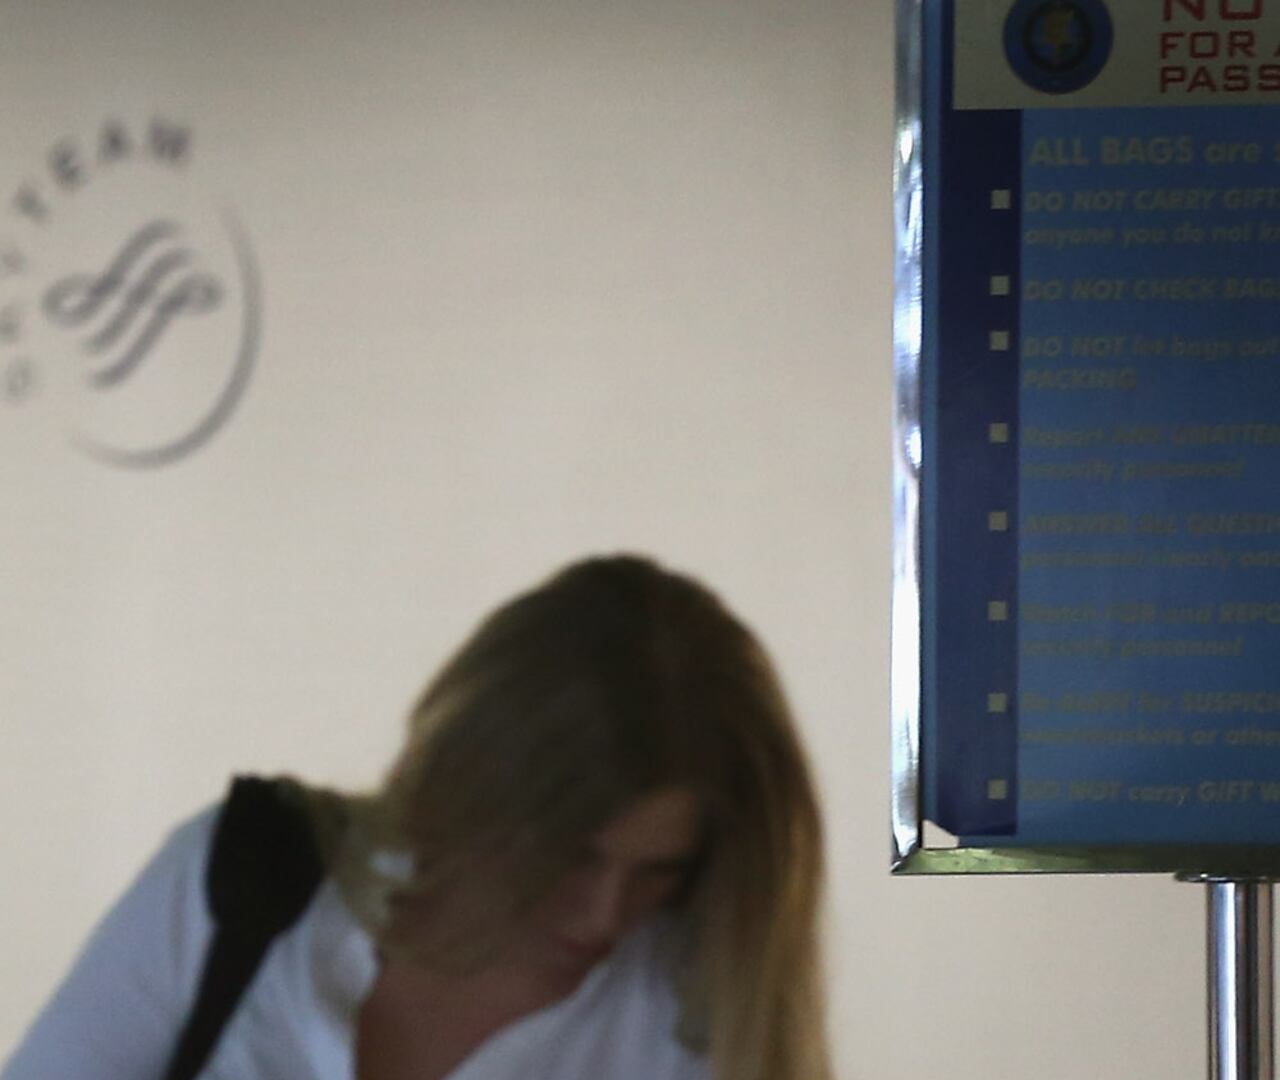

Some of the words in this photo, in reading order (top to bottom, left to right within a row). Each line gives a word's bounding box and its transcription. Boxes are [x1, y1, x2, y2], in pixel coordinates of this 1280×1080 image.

[1159, 30, 1256, 59] FOR
[1159, 64, 1280, 93] PASS
[1029, 138, 1089, 165] ALL
[1101, 136, 1195, 165] BAGS
[1204, 142, 1262, 165] are
[1024, 191, 1065, 212] DO
[1072, 190, 1127, 211] NOT
[1134, 188, 1215, 210] CARRY
[1121, 229, 1166, 250] you
[1024, 279, 1064, 301] DO
[1072, 279, 1126, 300] NOT
[1024, 336, 1062, 357] DO
[1072, 336, 1127, 357] NOT
[1199, 779, 1253, 801] GIFT
